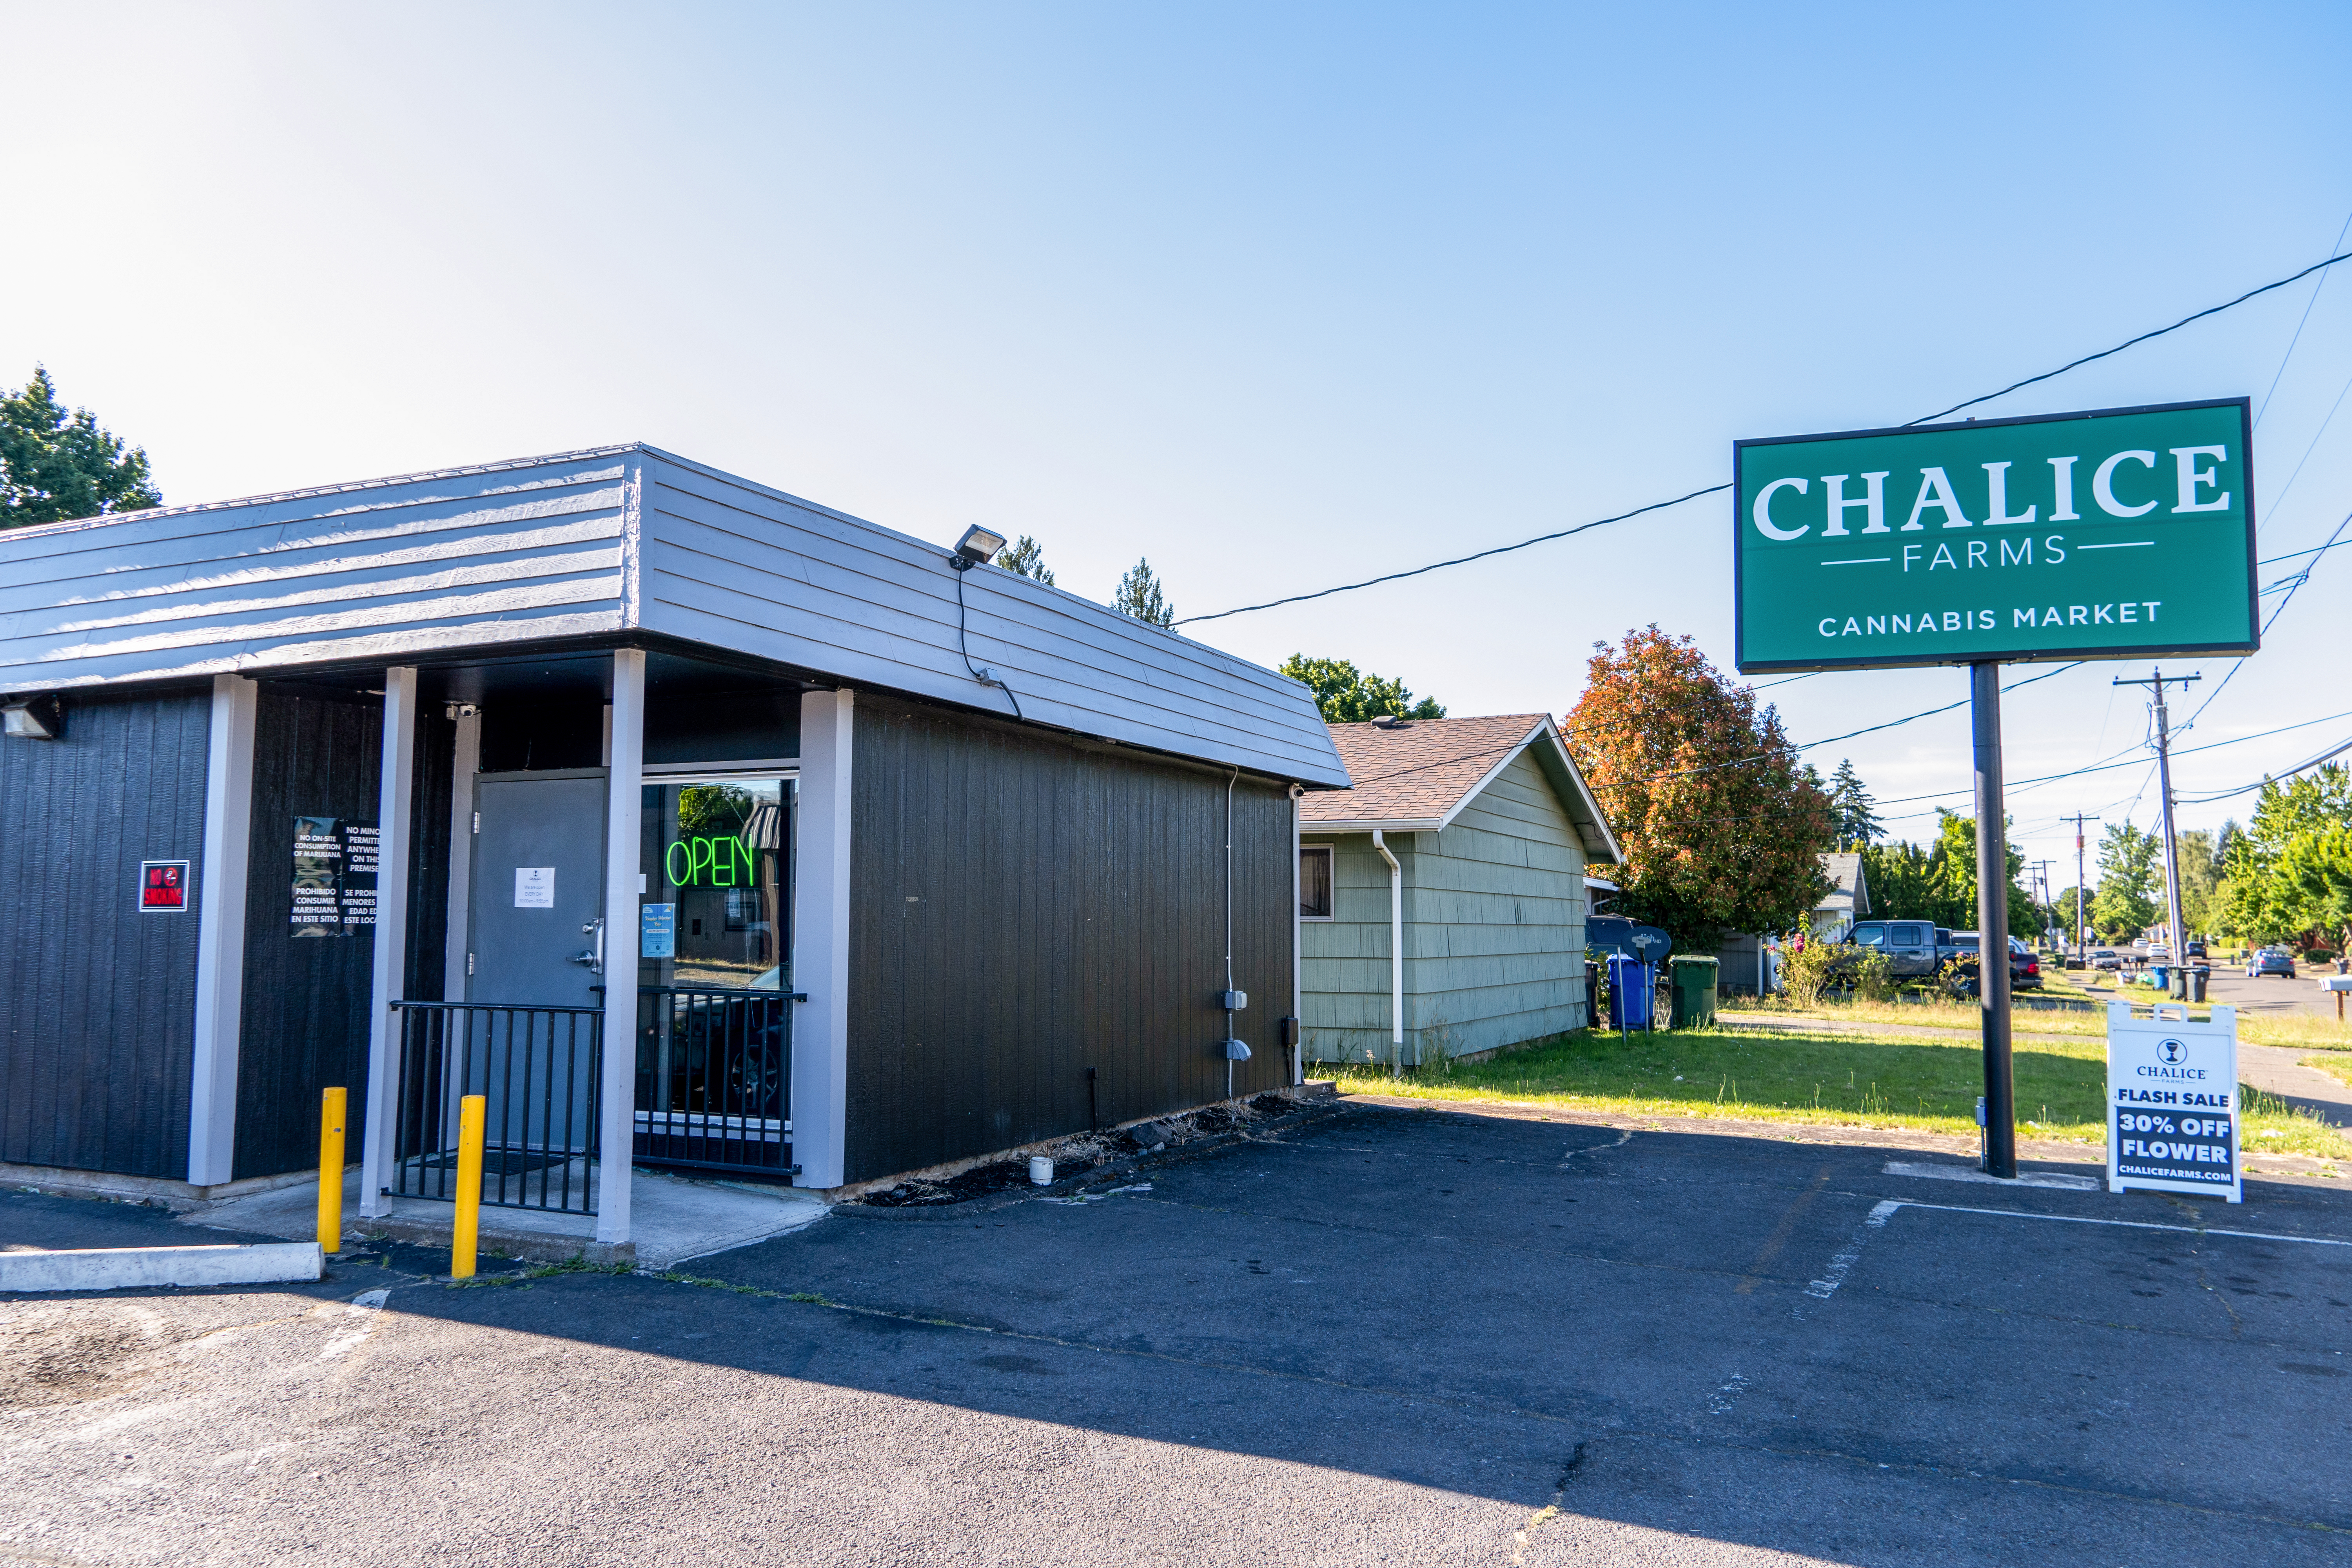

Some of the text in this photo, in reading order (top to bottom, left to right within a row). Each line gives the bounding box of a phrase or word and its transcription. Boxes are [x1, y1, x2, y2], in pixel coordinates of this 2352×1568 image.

[1753, 445, 2230, 541] CHALICE
[1903, 535, 2067, 572] FARMS
[1818, 601, 2162, 638] CANNABIS MARKET
[667, 833, 753, 886] OPEN
[145, 888, 182, 904] SMOKING
[2137, 1066, 2206, 1079] CHALICE
[2118, 1089, 2229, 1107] FLASH SALE
[2119, 1114, 2230, 1137] 30% OFF
[2123, 1139, 2229, 1163] FLOWER
[2119, 1165, 2231, 1181] CHALICEFARMS.COM
